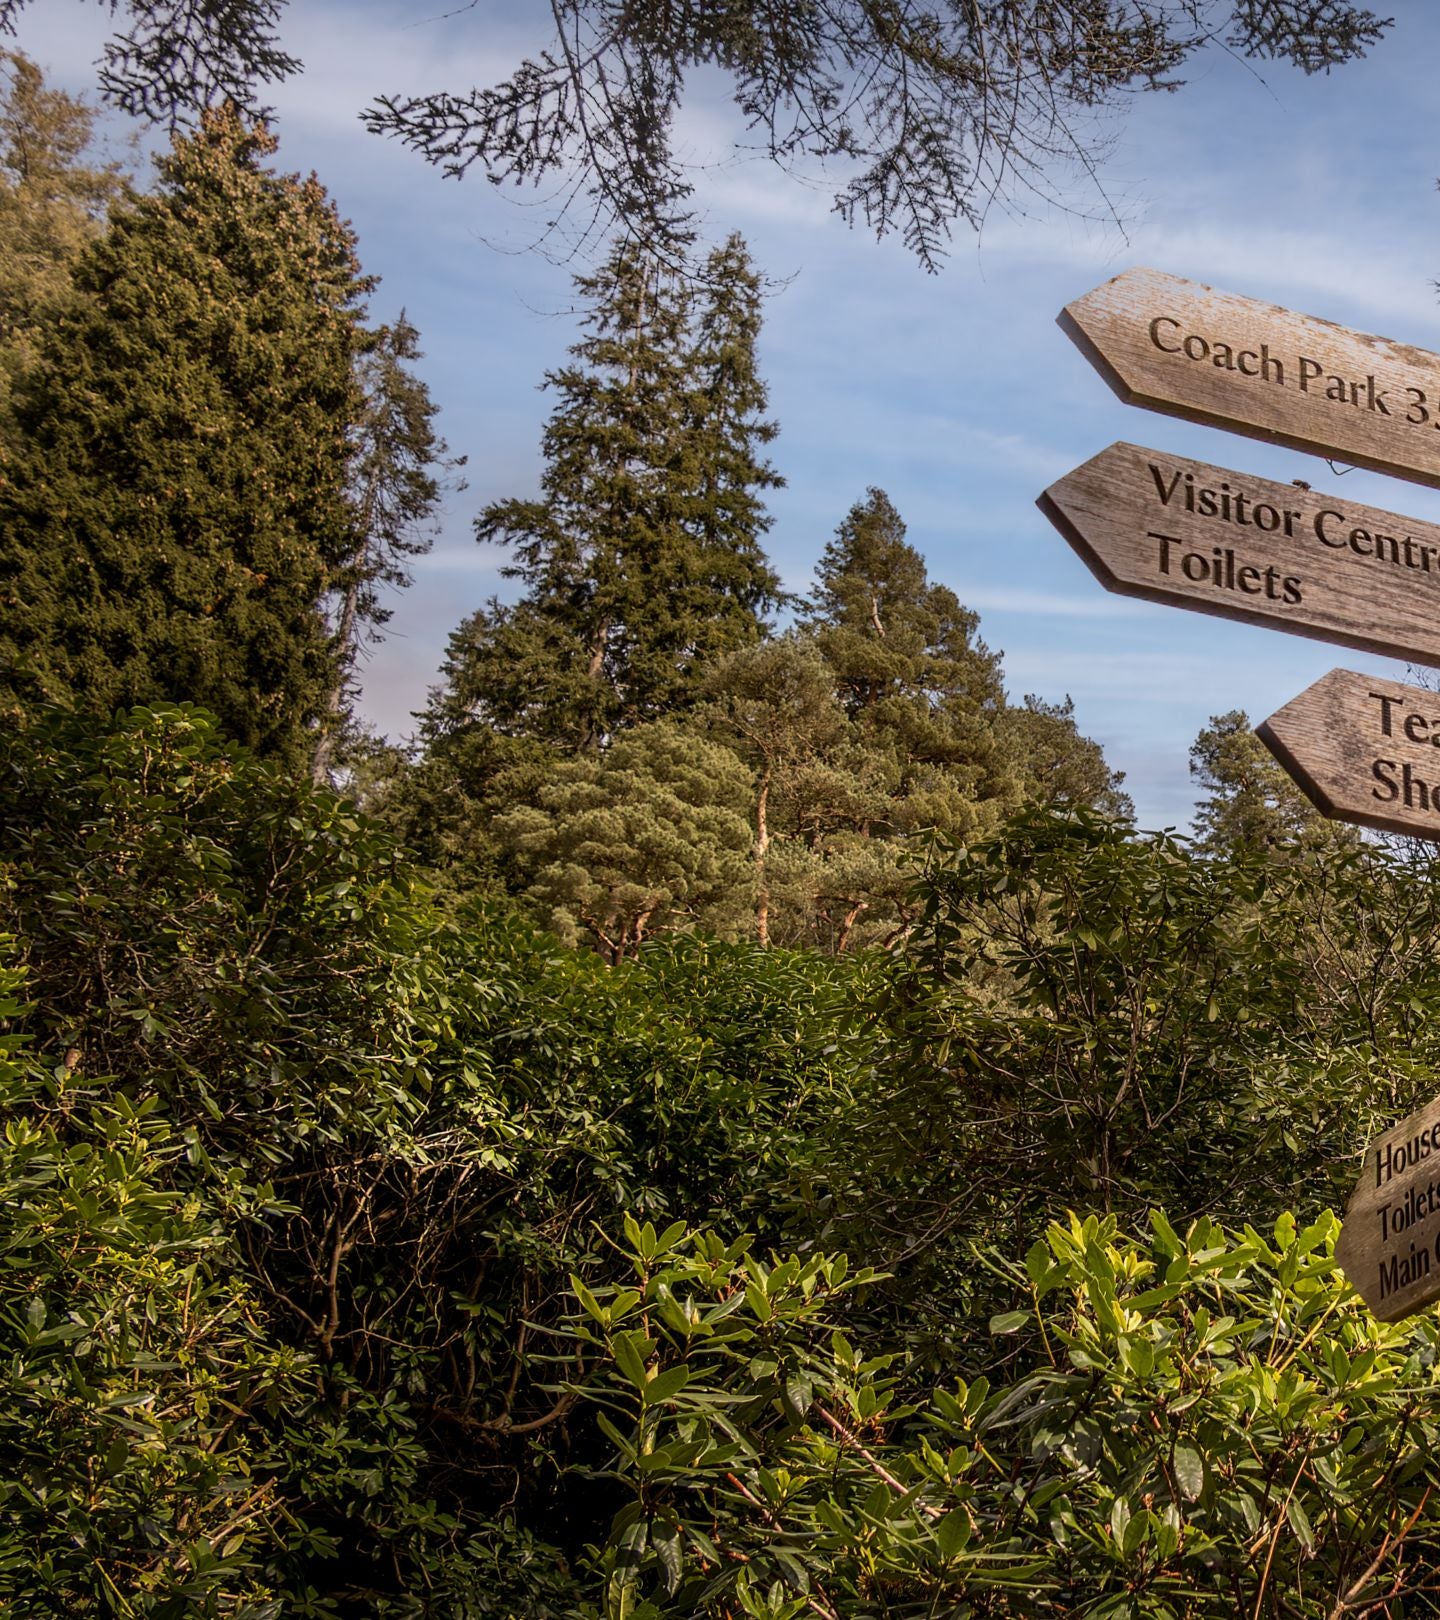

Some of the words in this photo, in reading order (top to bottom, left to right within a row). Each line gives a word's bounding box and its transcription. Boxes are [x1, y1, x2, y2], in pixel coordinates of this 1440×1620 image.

[1148, 316, 1284, 386] Coach
[1299, 357, 1392, 416] Park
[1147, 464, 1301, 538] Visitor
[1147, 532, 1302, 605] Toilets
[1378, 1244, 1430, 1300] Main
